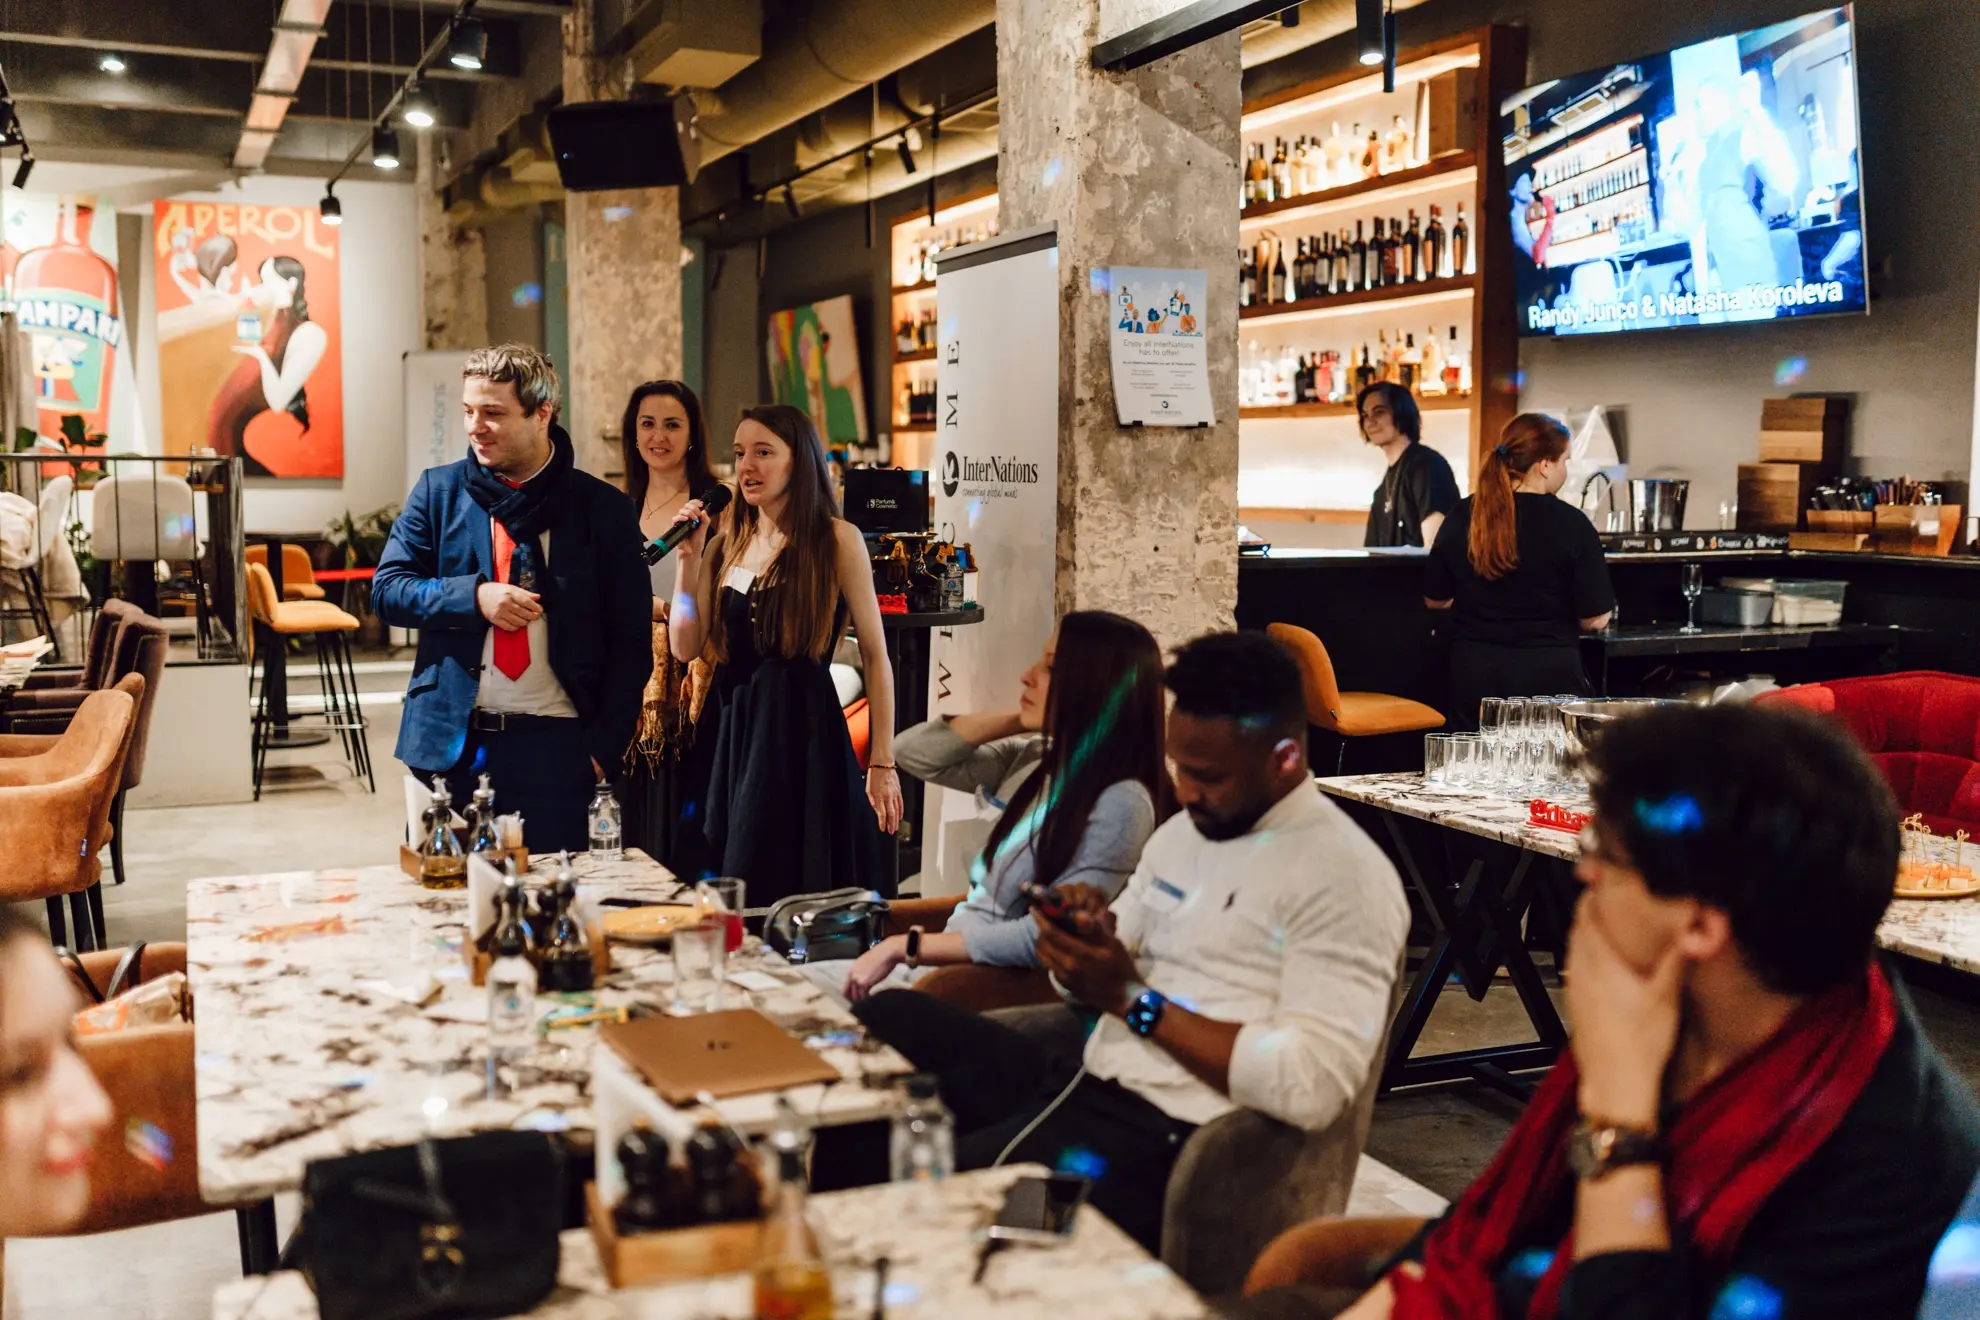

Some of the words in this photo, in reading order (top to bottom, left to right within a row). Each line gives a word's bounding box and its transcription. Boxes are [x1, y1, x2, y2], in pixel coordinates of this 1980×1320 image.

[157, 203, 335, 260] APEROL
[1527, 304, 1580, 329] Randy
[1584, 301, 1637, 323] Junco
[1641, 295, 1656, 318] &
[1660, 289, 1743, 316] Natasha
[1747, 277, 1844, 308] Koroleva
[15, 300, 121, 348] AMPARI
[1123, 339, 1142, 348] Enjoy
[1138, 348, 1152, 356] has
[962, 456, 1038, 483] InterNations
